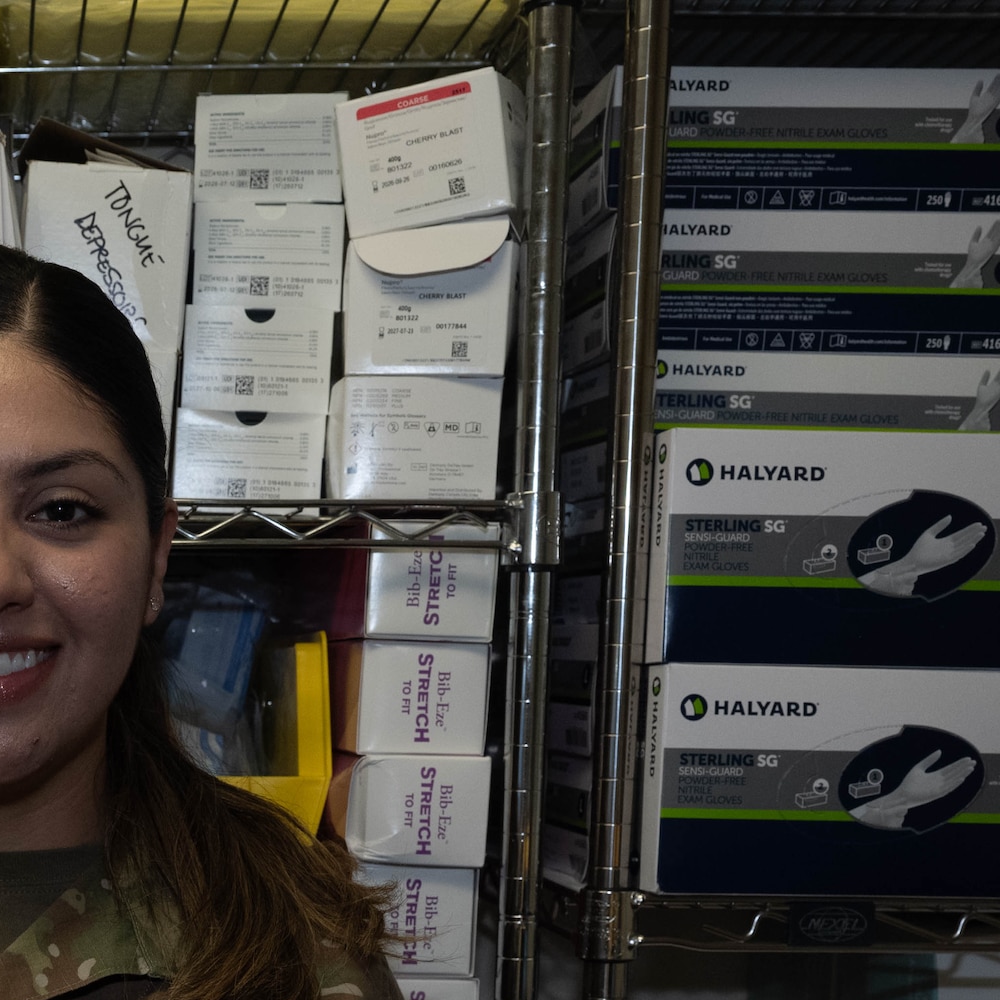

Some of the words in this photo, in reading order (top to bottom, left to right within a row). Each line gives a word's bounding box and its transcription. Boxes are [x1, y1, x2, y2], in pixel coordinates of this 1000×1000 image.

[669, 80, 729, 91] ALYARD
[397, 95, 429, 109] COARSE
[713, 111, 735, 125] SG
[406, 134, 438, 146] CHERRY
[440, 127, 464, 138] BLAST
[699, 127, 773, 138] POWDER-FREE
[776, 128, 813, 138] NITRILE
[816, 129, 844, 138] EXAM
[848, 128, 888, 138] GLOVES
[926, 195, 943, 205] 250
[105, 180, 165, 268] TONGUE
[714, 254, 737, 269] SG
[701, 271, 775, 282] POWDER-FREE
[778, 272, 814, 282] NITRILE
[817, 273, 844, 282] EXAM
[848, 273, 888, 283] GLOVES
[926, 339, 942, 350] 250
[672, 364, 745, 377] HALYARD
[657, 393, 726, 408] TERLING
[729, 394, 752, 408] SG
[716, 410, 789, 422] POWDER-FREE
[791, 412, 829, 422] NITRILE
[831, 413, 857, 423] EXAM
[863, 414, 899, 424] GLOVES
[445, 423, 459, 431] MD
[720, 465, 825, 481] HALYARD
[656, 469, 665, 547] HALYARD
[685, 519, 760, 532] STERLING
[764, 519, 786, 533] SG
[684, 532, 750, 542] SENSI-GUARD
[684, 542, 753, 552] POWDER-FREE
[683, 552, 719, 561] NITRILE
[448, 563, 458, 579] FIT
[683, 562, 710, 571] EXAM
[712, 562, 750, 571] GLOVES
[446, 582, 456, 599] TO
[402, 680, 412, 696] TO
[413, 653, 434, 743] STRETCH
[401, 698, 412, 715] FIT
[714, 700, 817, 717] HALYARD
[649, 701, 659, 777] HALYARD
[679, 753, 754, 766] STERLING
[756, 754, 779, 768] SG
[678, 766, 744, 777] SENSI-GUARD
[678, 776, 747, 786] POWDER-FREE
[678, 786, 713, 795] NITRILE
[404, 793, 415, 808] TO
[677, 795, 704, 805] EXAM
[705, 796, 743, 805] GLOVES
[415, 766, 437, 856] STRETCH
[404, 811, 414, 828] FIT
